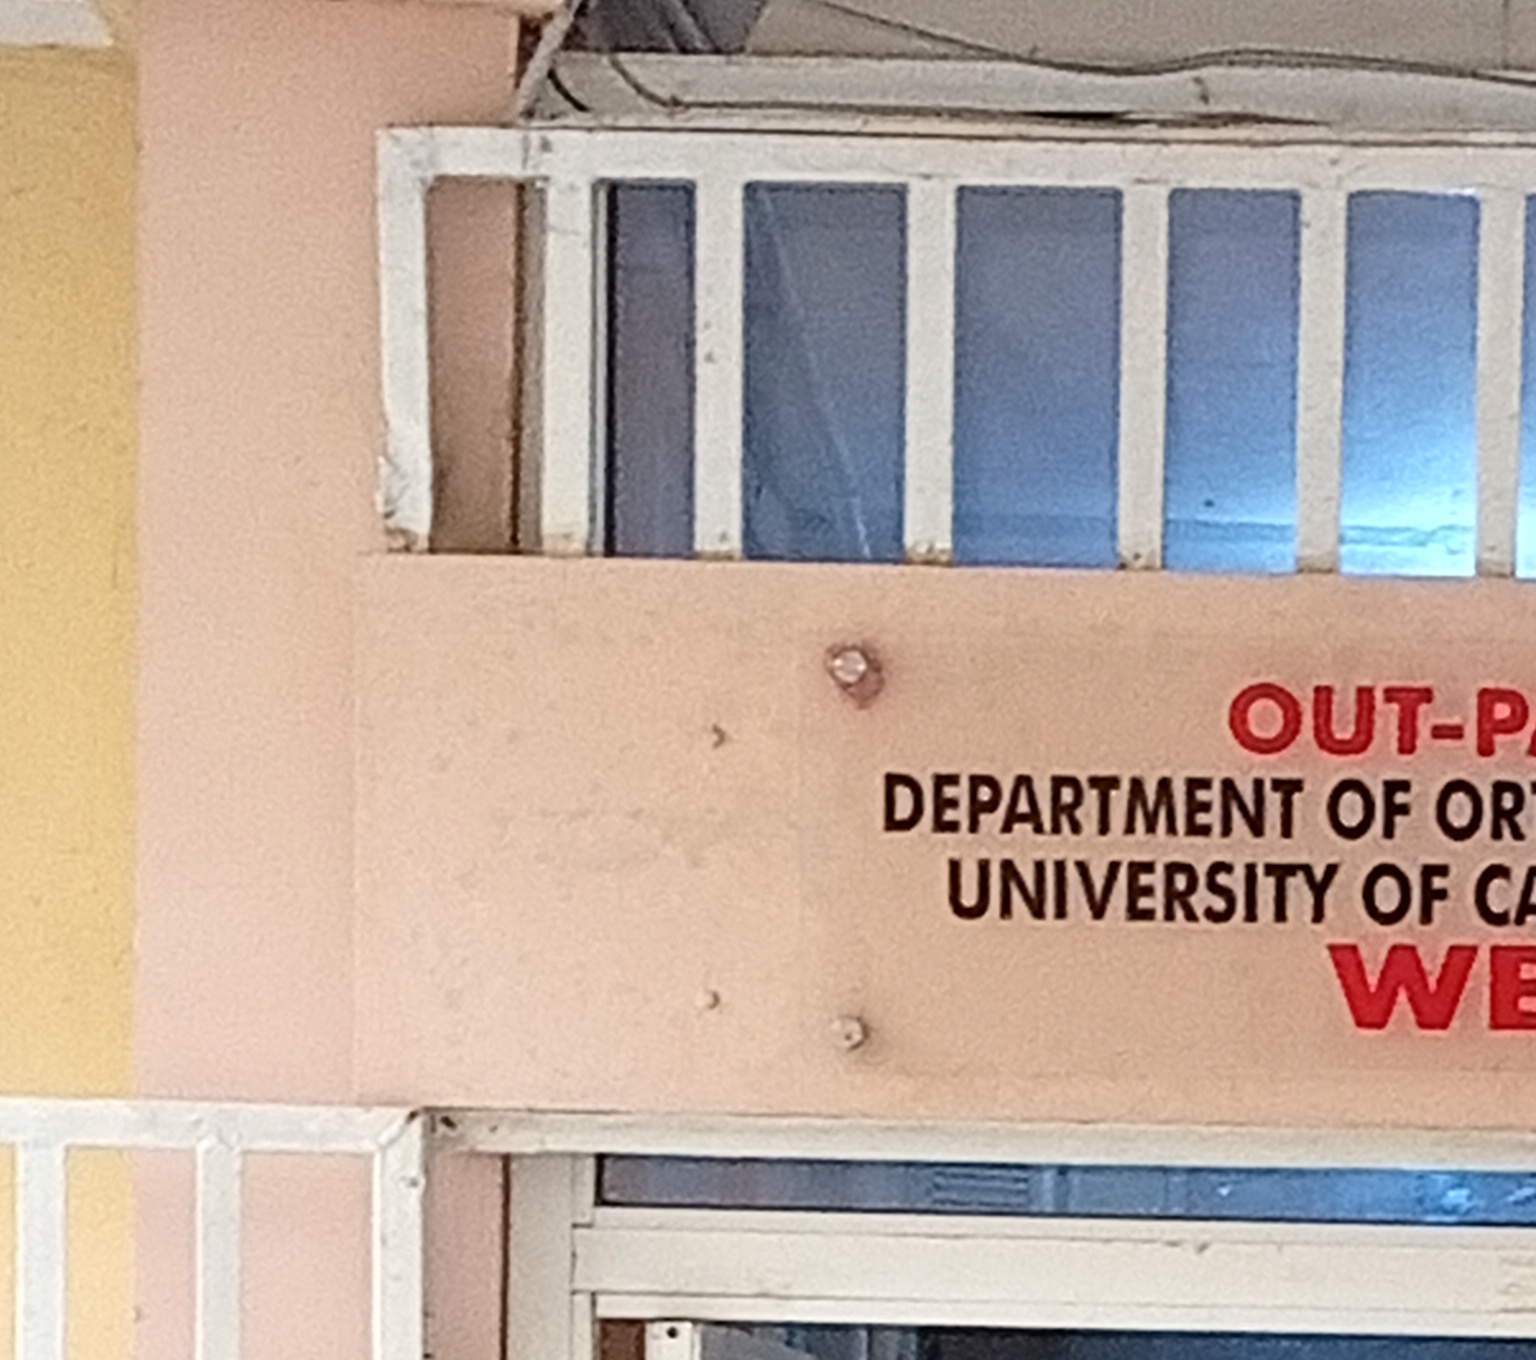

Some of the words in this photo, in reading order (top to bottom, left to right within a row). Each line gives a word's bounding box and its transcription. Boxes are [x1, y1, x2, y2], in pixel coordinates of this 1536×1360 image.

[883, 773, 1304, 838] DEPARTMENT
[1327, 779, 1412, 842] OF
[947, 858, 1340, 924] UNIVERSITY
[1361, 863, 1450, 926] OF
